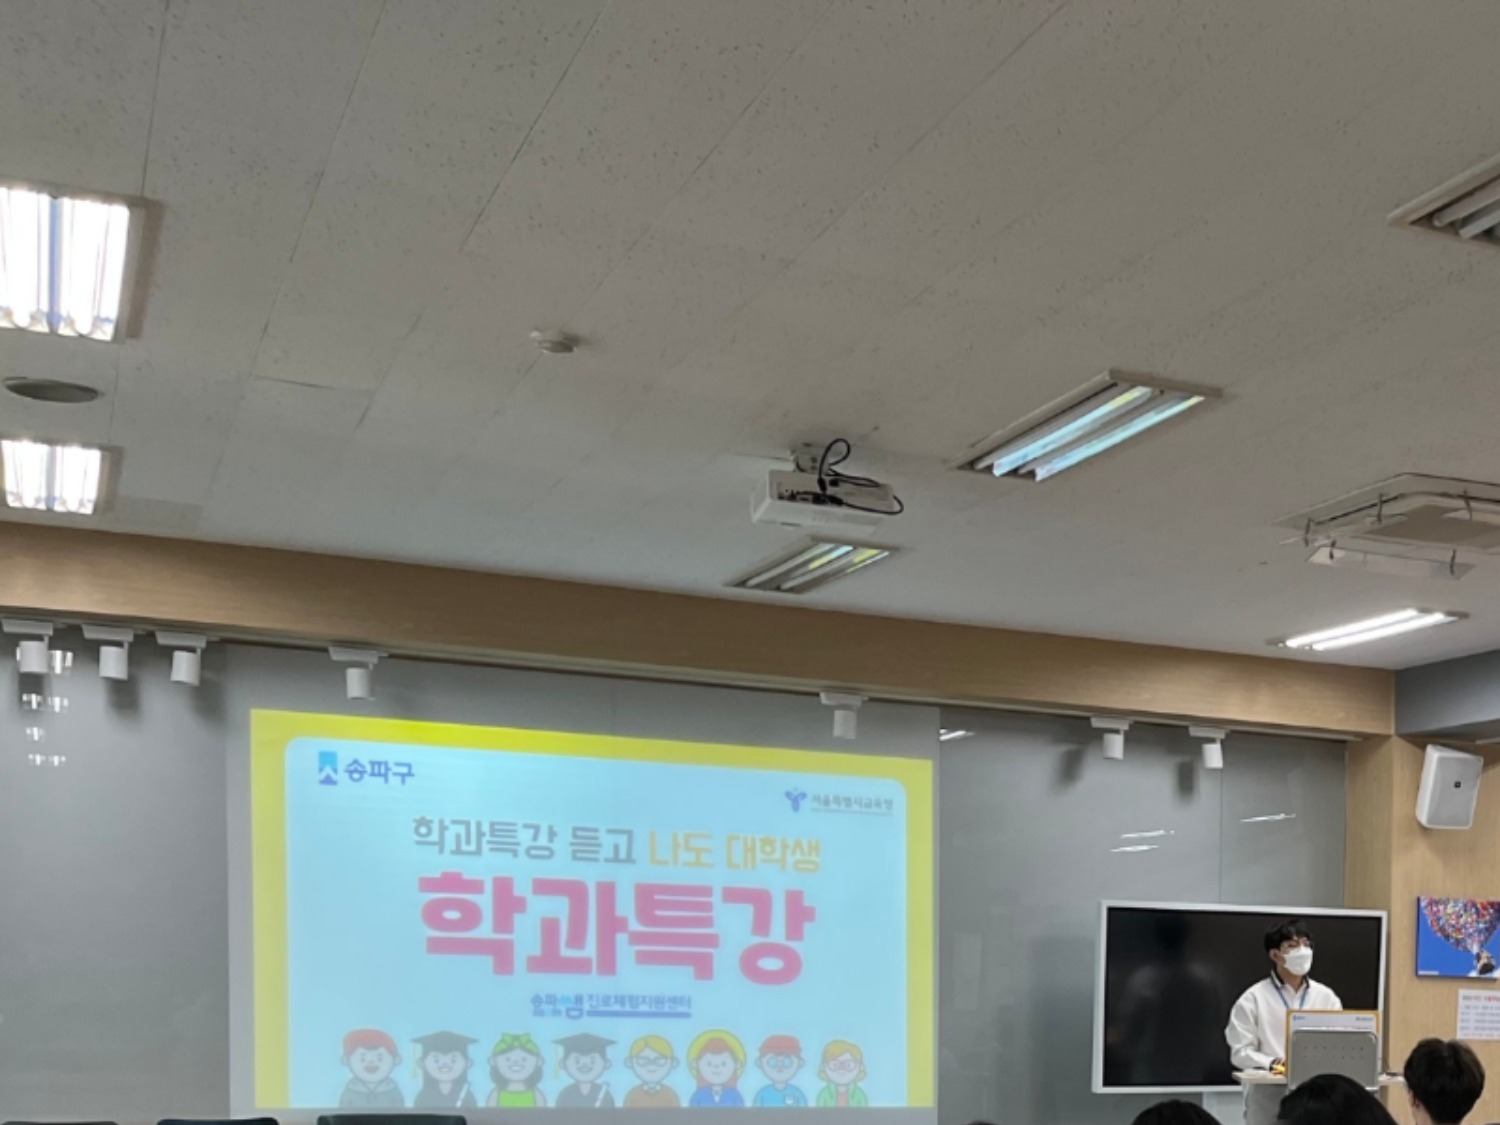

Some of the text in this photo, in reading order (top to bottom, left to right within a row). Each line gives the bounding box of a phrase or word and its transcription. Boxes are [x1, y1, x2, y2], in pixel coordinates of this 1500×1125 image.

[344, 758, 415, 785] 송파구
[412, 815, 821, 874] 학과특강 듣고 나도 대학생
[417, 871, 816, 987] 학과특강
